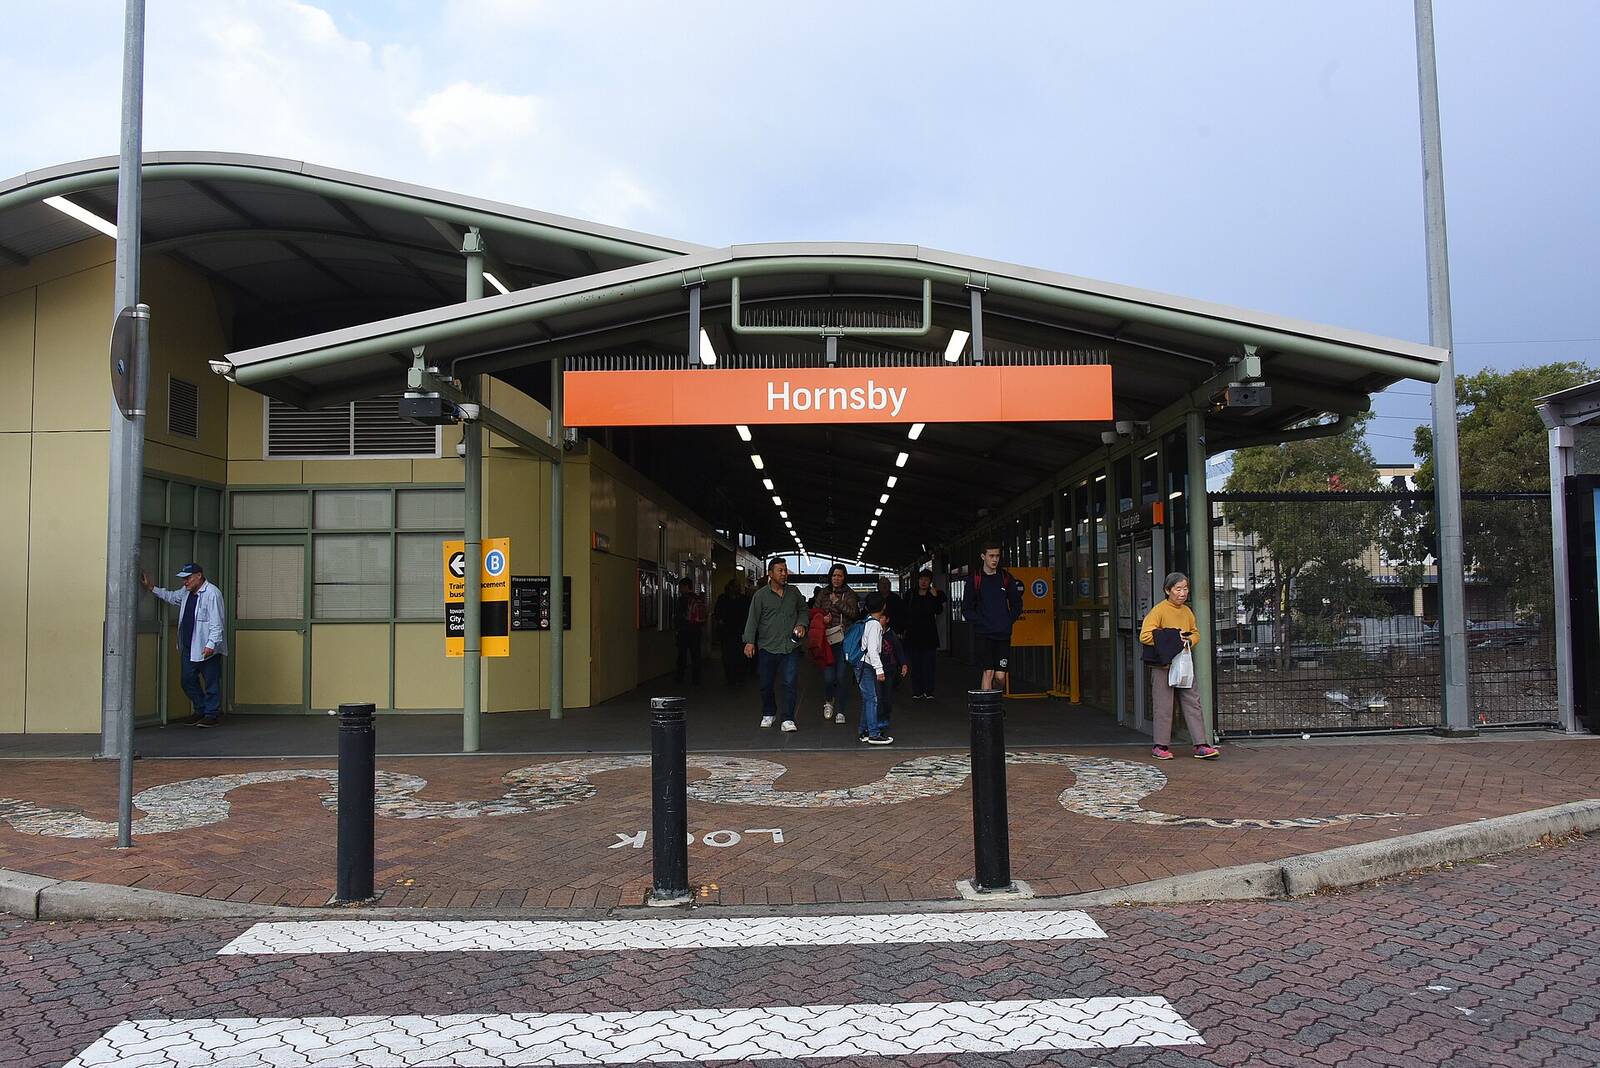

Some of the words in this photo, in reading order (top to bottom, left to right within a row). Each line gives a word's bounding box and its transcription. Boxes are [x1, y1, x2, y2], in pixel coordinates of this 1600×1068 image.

[767, 379, 908, 417] Hornsby
[491, 555, 500, 570] B
[449, 615, 461, 623] City
[607, 828, 784, 849] LOK
